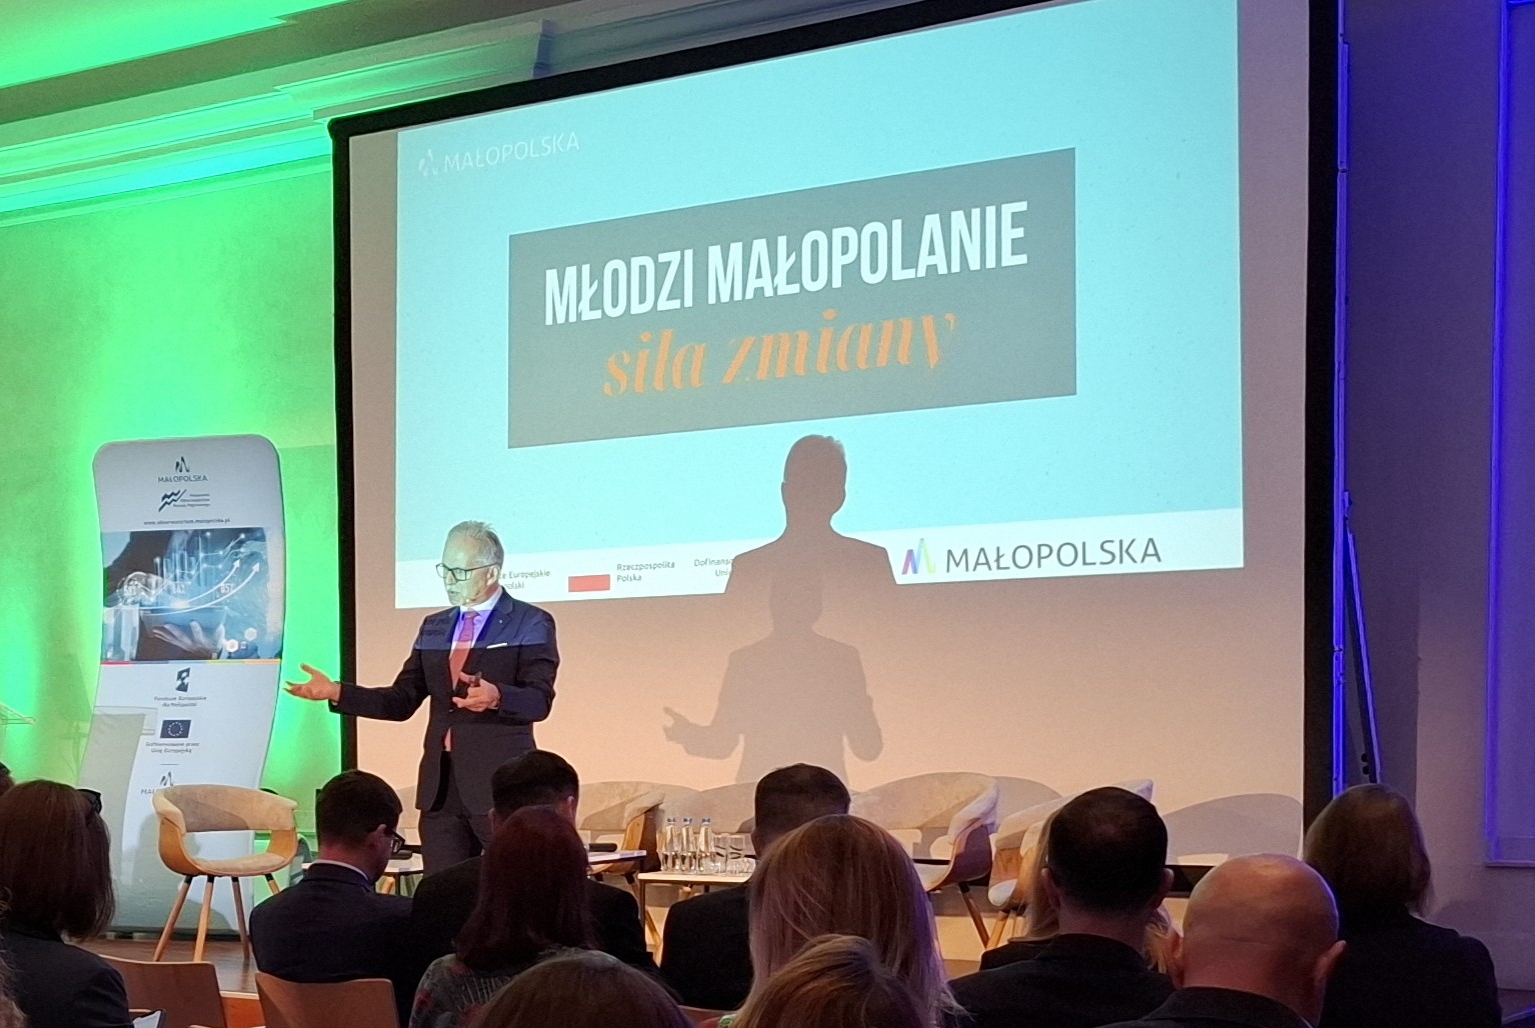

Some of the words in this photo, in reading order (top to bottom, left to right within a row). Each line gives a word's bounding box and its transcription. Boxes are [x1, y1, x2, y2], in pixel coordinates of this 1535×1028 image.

[443, 131, 580, 174] MAŁOPOLSKA
[544, 248, 694, 326] MŁODZI
[707, 200, 1028, 305] MAŁOPOLANIE
[721, 308, 958, 384] zmiany
[946, 537, 1162, 573] MAŁOPOLSKA
[616, 573, 642, 583] Polska
